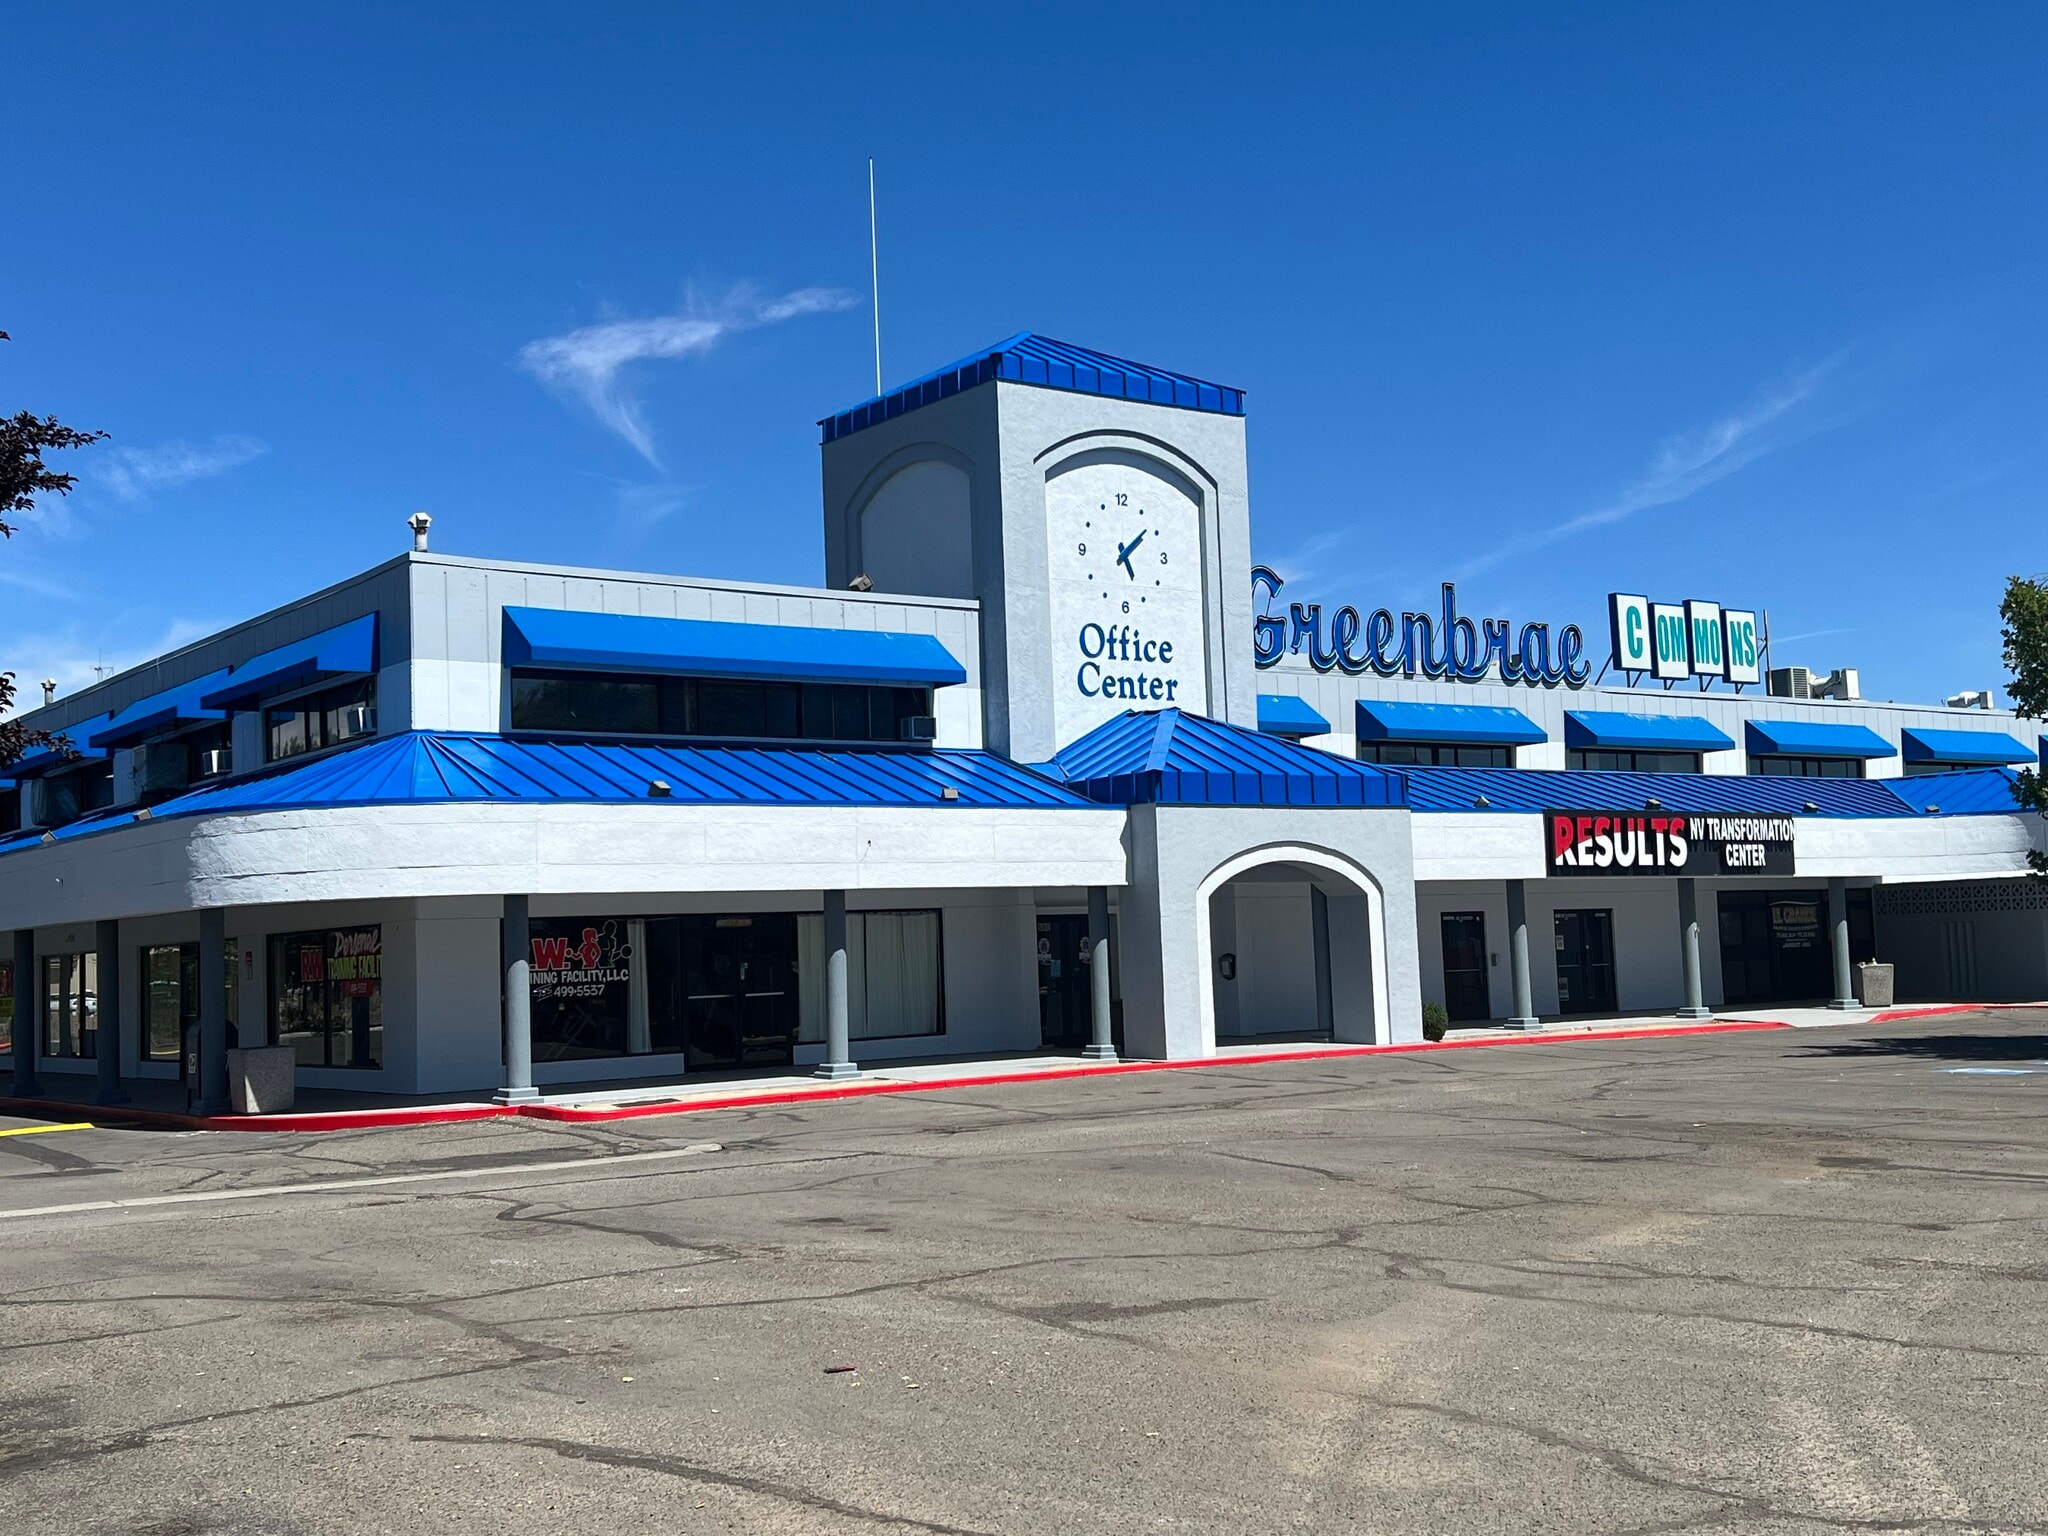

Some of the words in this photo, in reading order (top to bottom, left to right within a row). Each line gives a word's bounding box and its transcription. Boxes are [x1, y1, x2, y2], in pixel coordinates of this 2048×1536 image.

[1115, 493, 1128, 507] 12
[1078, 543, 1087, 556] 9
[1160, 552, 1168, 565] 3
[1121, 601, 1130, 614] 6
[1251, 565, 1591, 688] Greenbrae
[1626, 605, 1756, 668] COMMONS
[1079, 622, 1173, 664] Office
[1077, 661, 1178, 701] Center
[1553, 815, 1688, 867] RESULTS
[1690, 817, 1705, 841] NV
[1707, 817, 1796, 842] TRANSFORMATION
[1725, 843, 1766, 867] CENTER
[335, 929, 382, 956] Personal
[327, 956, 357, 981] TRAINING
[358, 954, 384, 979] FACILIT
